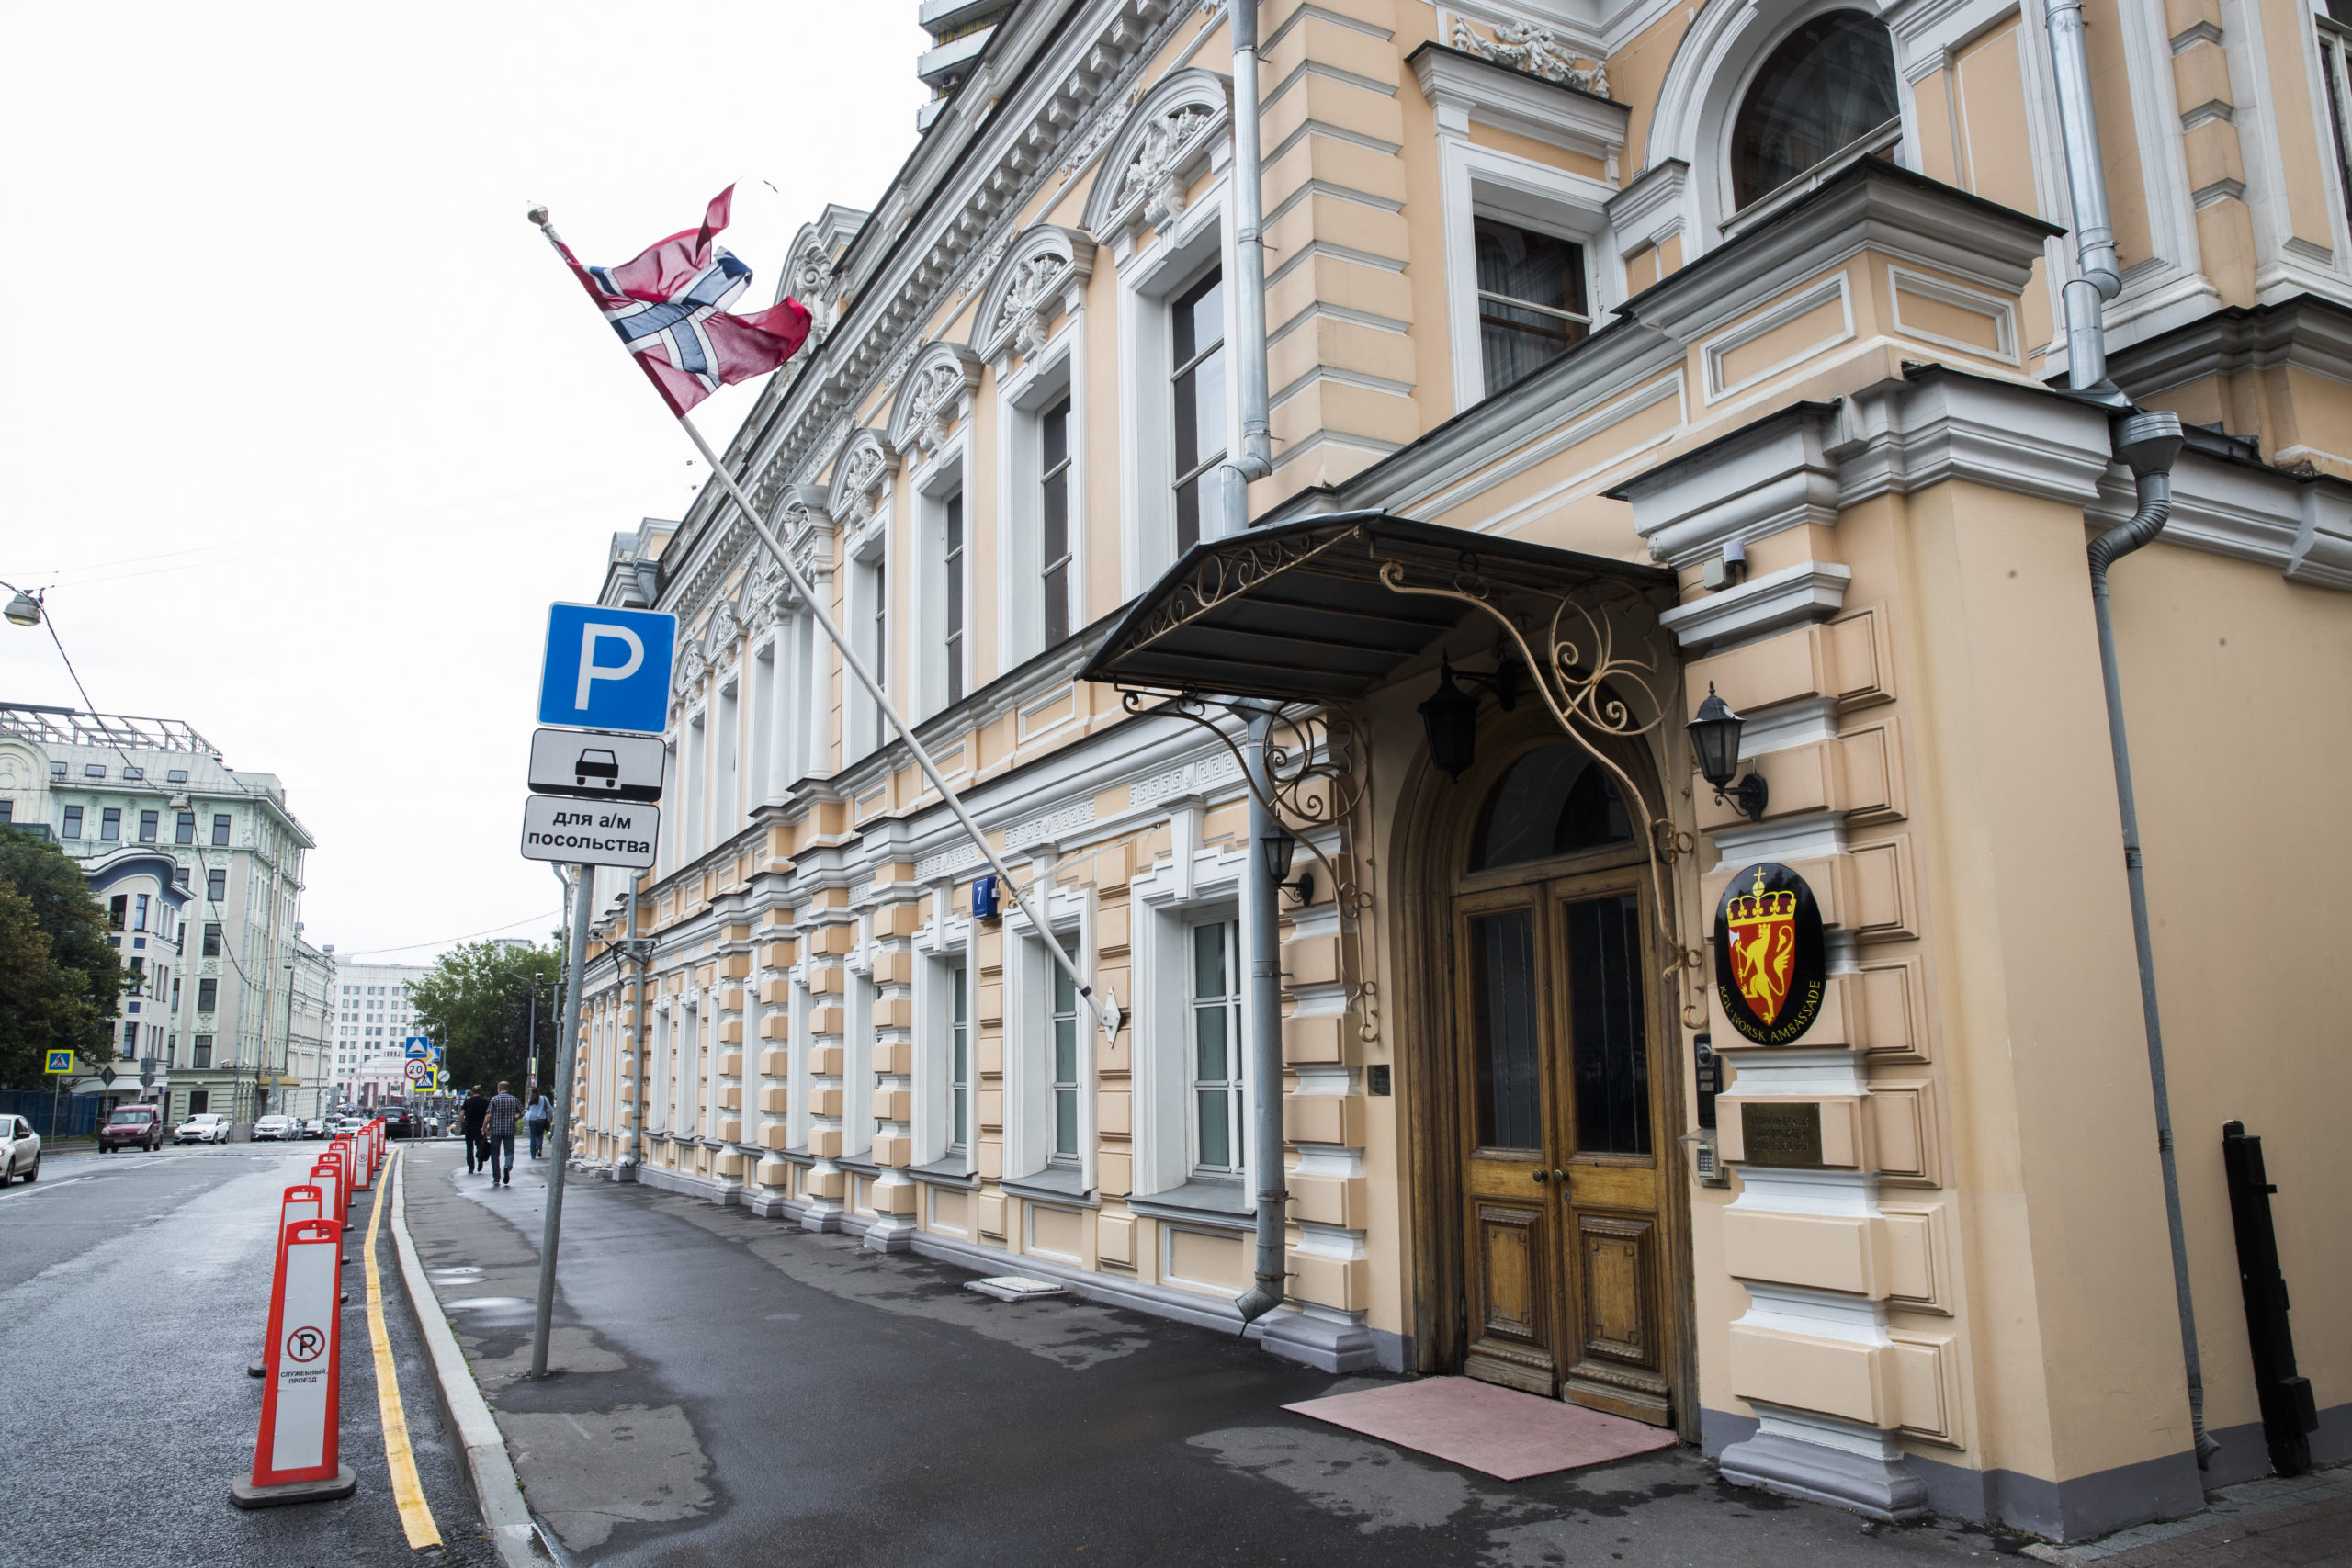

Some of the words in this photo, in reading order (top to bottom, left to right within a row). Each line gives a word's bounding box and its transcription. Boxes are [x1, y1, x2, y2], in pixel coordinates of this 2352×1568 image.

[574, 622, 644, 711] P
[552, 812, 593, 827] для
[598, 812, 631, 829] а/м
[528, 832, 650, 853] посольства
[977, 886, 983, 905] 7
[1731, 1012, 1767, 1042] NORSK
[1770, 980, 1821, 1042] AMBASSADE
[409, 1066, 423, 1074] 20
[299, 1334, 316, 1356] P
[280, 1369, 325, 1378] СЛУЖЕБНЫЙ
